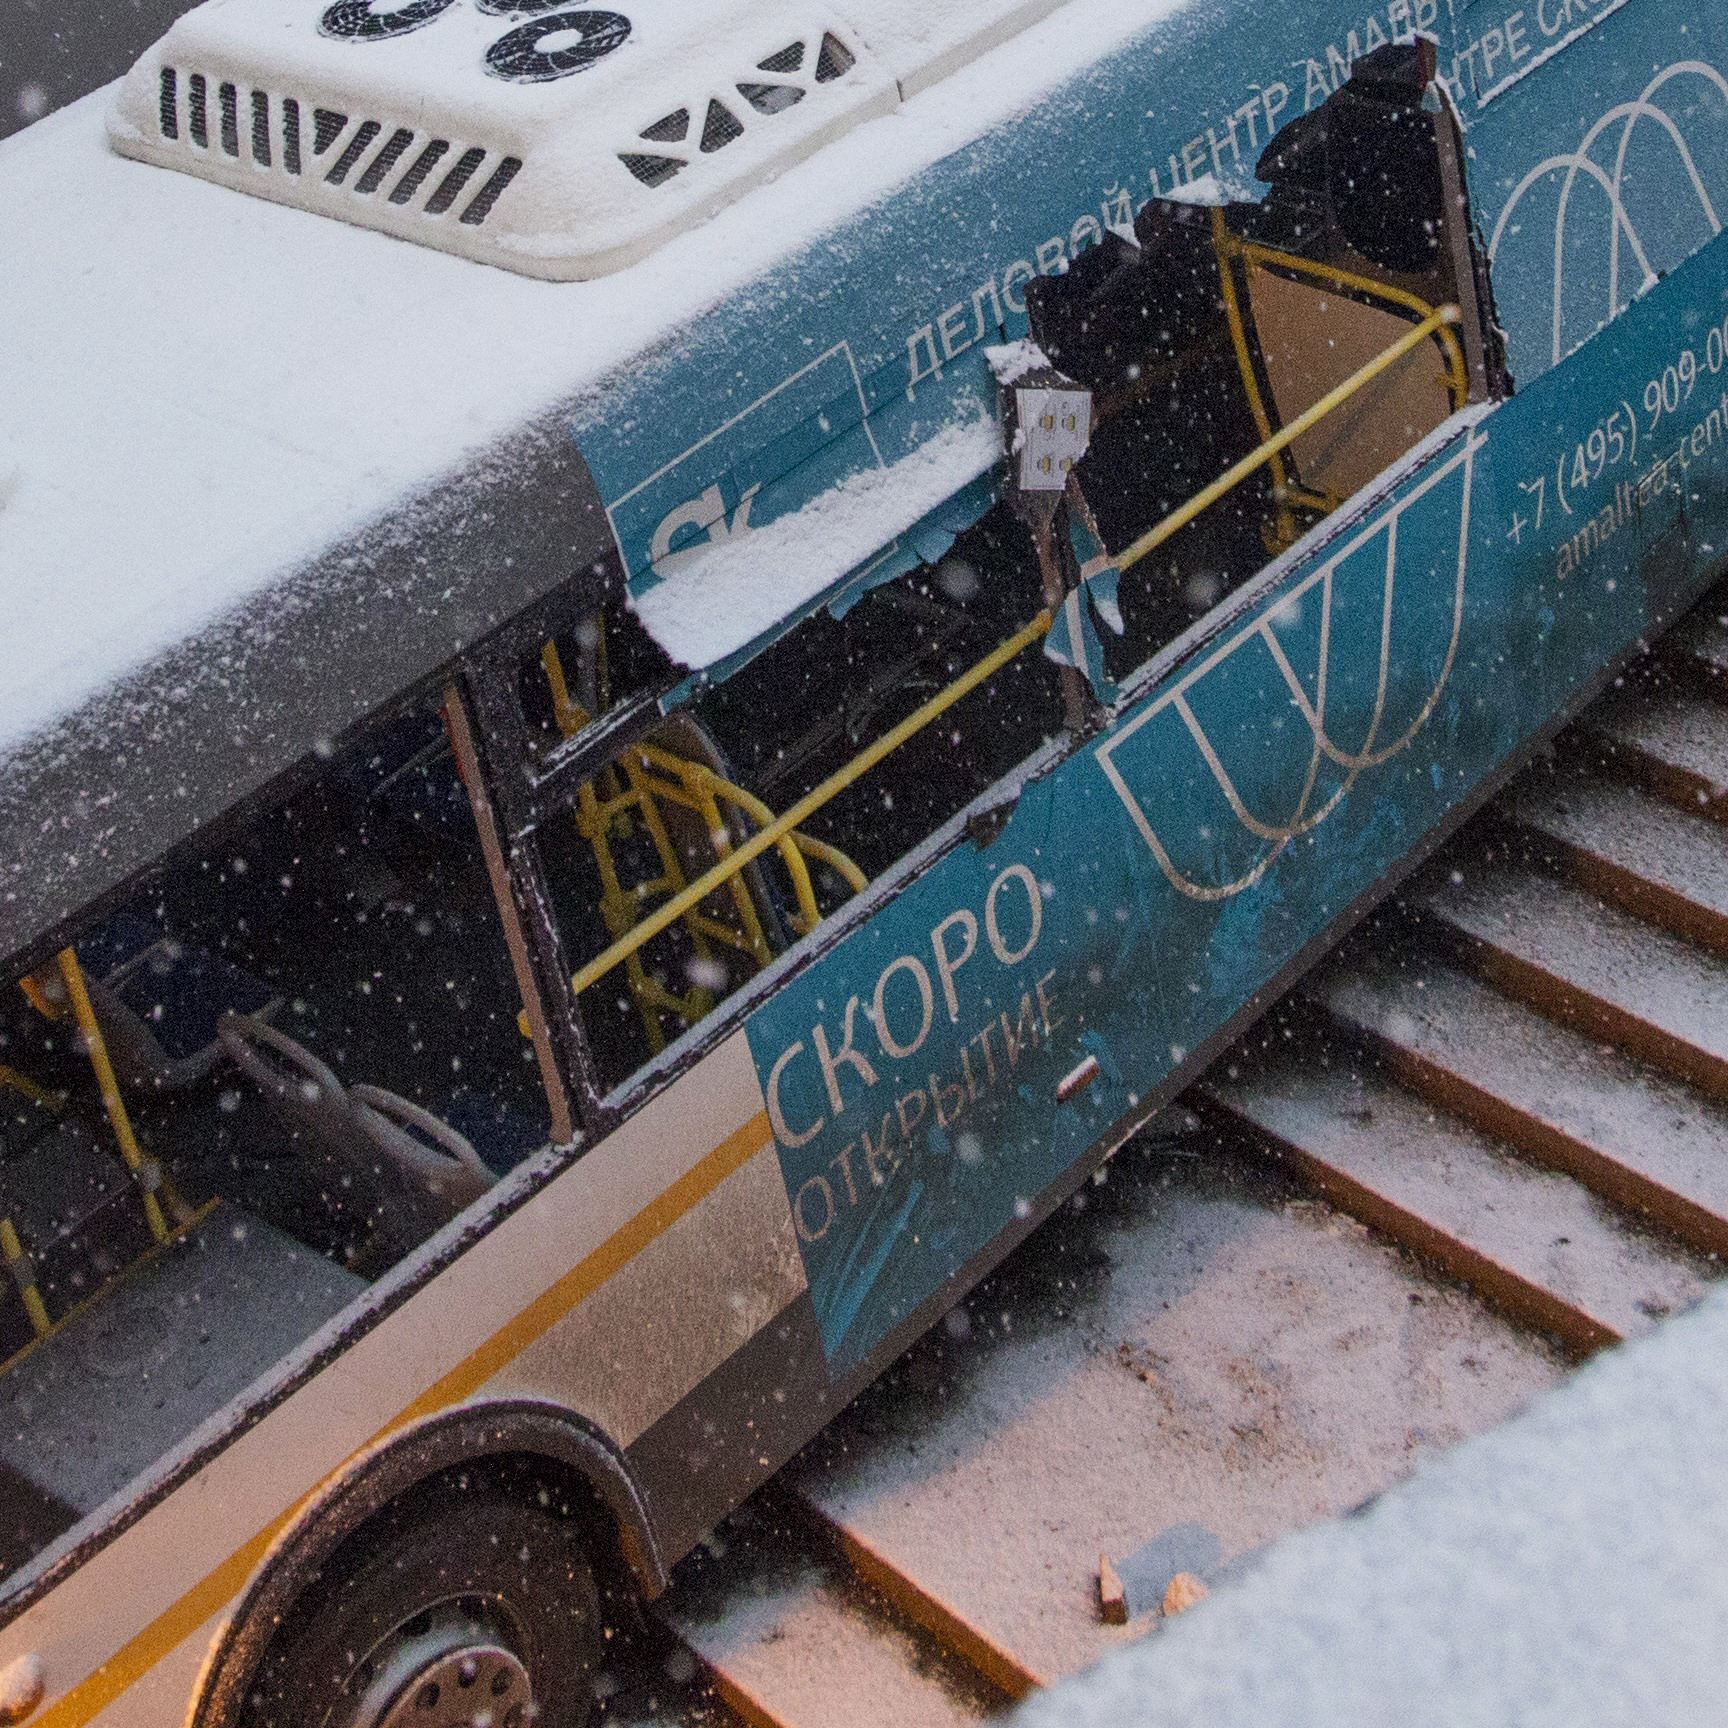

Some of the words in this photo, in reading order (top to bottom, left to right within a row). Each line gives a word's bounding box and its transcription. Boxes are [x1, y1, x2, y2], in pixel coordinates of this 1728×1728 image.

[1436, 11, 1531, 101] НТРЕ
[1505, 475, 1545, 545] +7
[1557, 400, 1636, 515] (495)
[767, 863, 1043, 1148] СКОРО
[794, 968, 1066, 1243] ОТКРЫТИЕ
